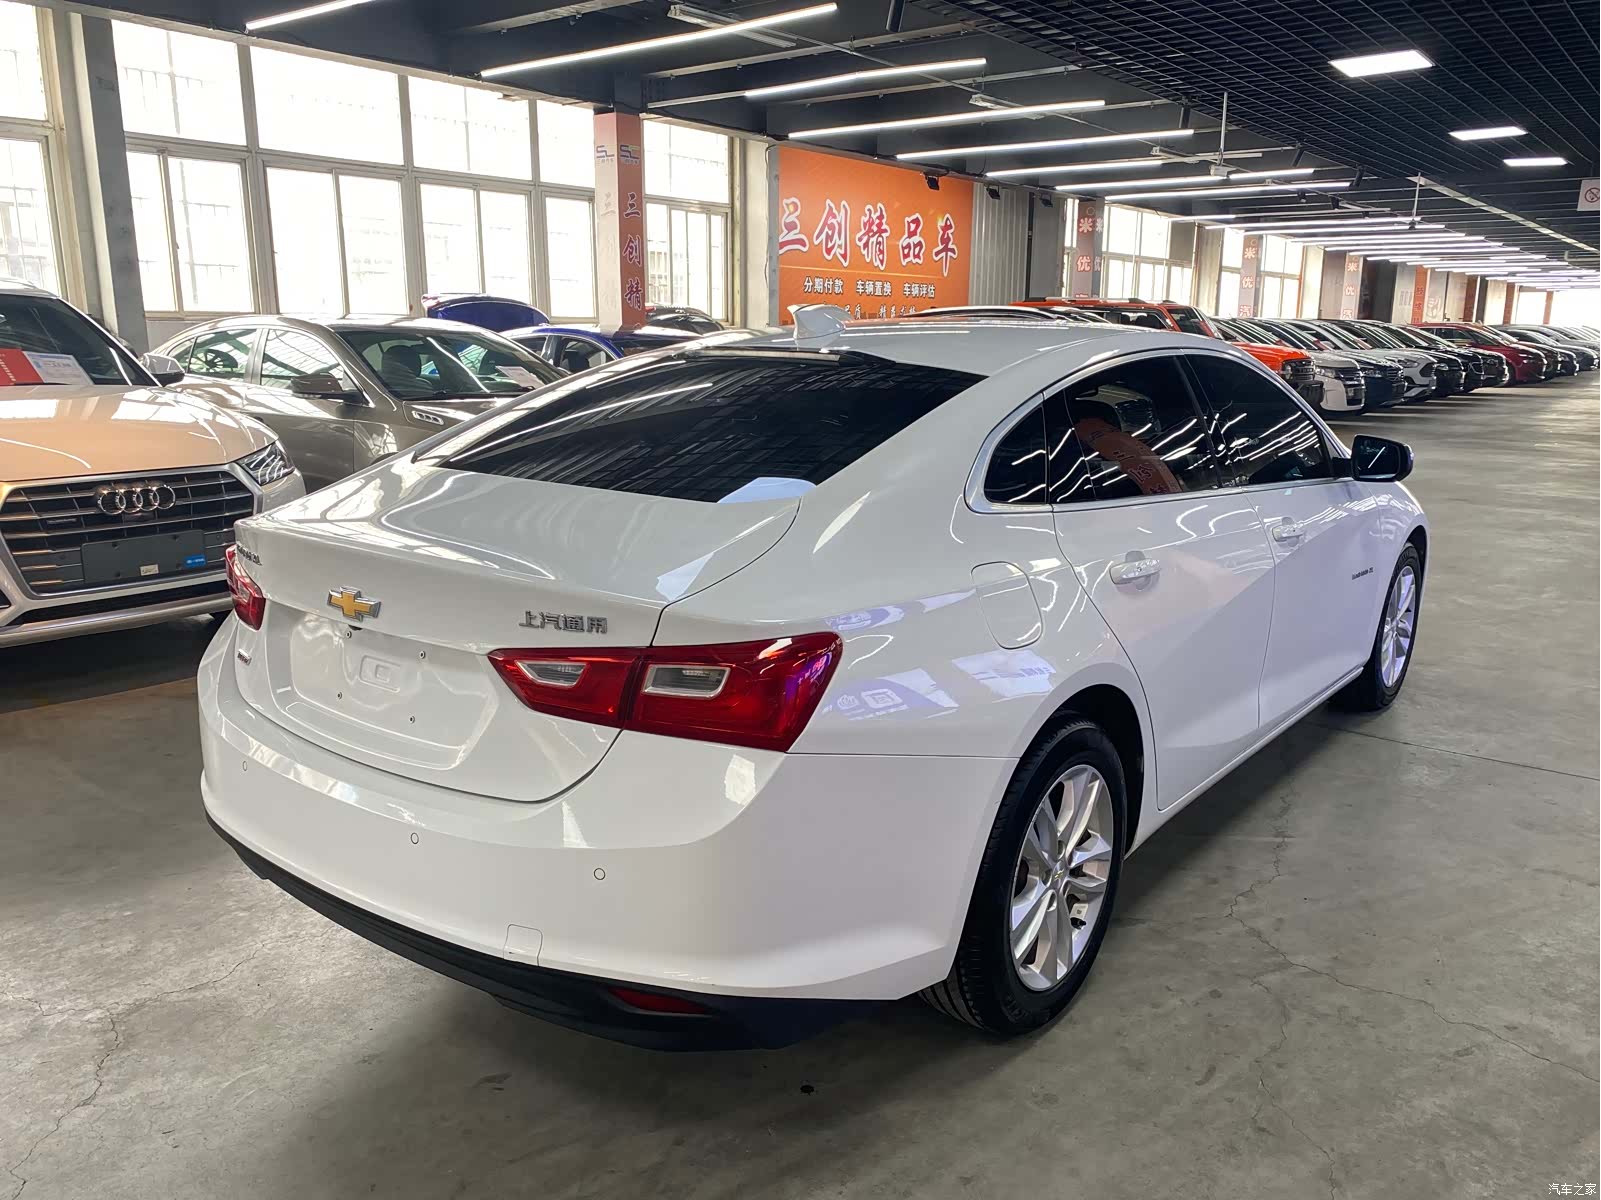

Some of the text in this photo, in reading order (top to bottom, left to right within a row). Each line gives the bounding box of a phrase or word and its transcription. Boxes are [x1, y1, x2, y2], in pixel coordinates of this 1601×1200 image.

[623, 191, 643, 329] 三创精
[779, 197, 957, 276] 三创精品车
[804, 277, 936, 298] 分期付款 车辆置换 车辆评估
[519, 610, 608, 634] 上汽通用
